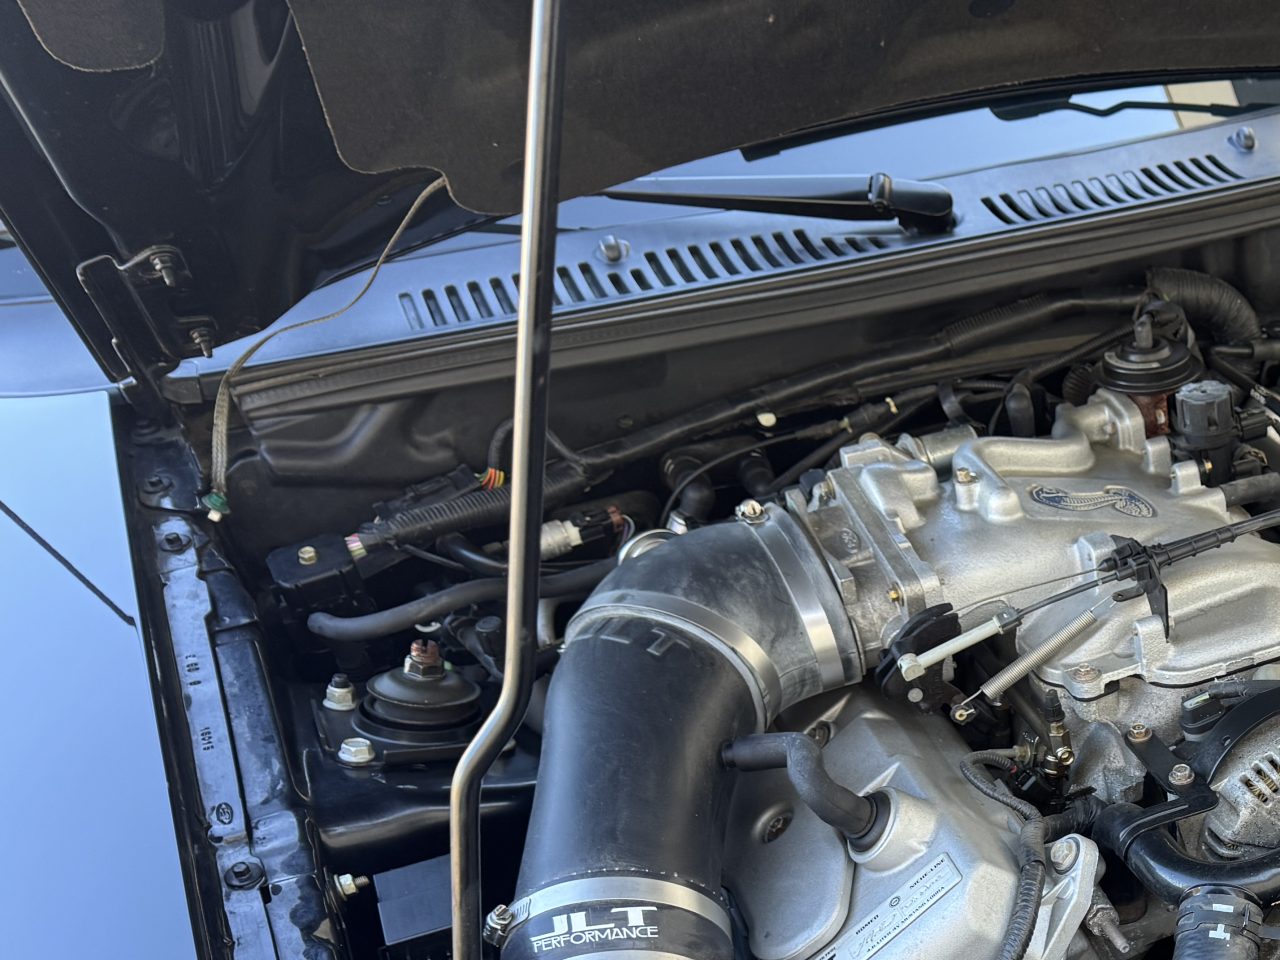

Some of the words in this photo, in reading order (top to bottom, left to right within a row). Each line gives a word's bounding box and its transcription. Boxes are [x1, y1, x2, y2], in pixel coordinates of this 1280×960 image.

[856, 914, 879, 935] ROMEO
[910, 859, 945, 889] NICHE-LINE
[530, 906, 658, 942] JLT
[533, 926, 659, 953] PERFORMANCE
